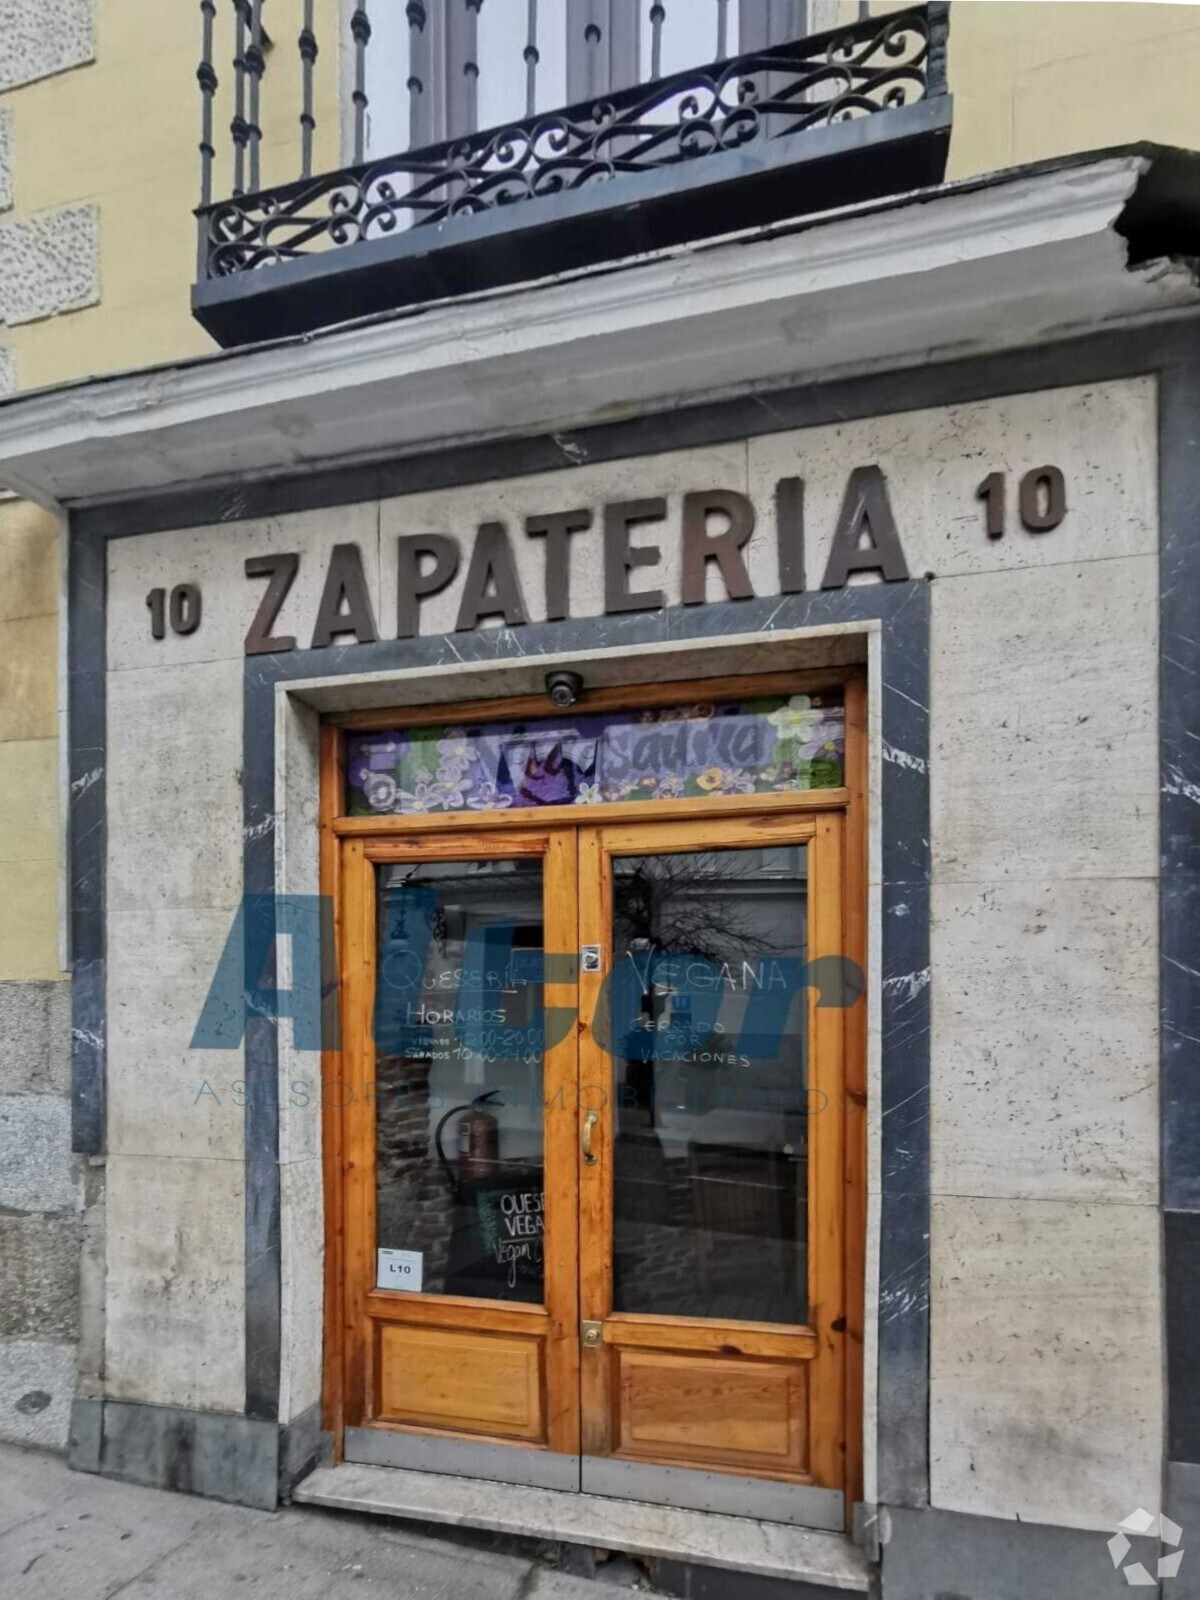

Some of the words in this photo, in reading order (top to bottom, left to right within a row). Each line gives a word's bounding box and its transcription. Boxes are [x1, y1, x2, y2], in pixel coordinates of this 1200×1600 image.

[975, 465, 1066, 540] 10
[245, 464, 909, 656] ZAPATERIA
[146, 583, 202, 640] 10
[626, 944, 788, 995] VEGANA
[664, 1034, 703, 1046] POR
[389, 1264, 412, 1275] L10
